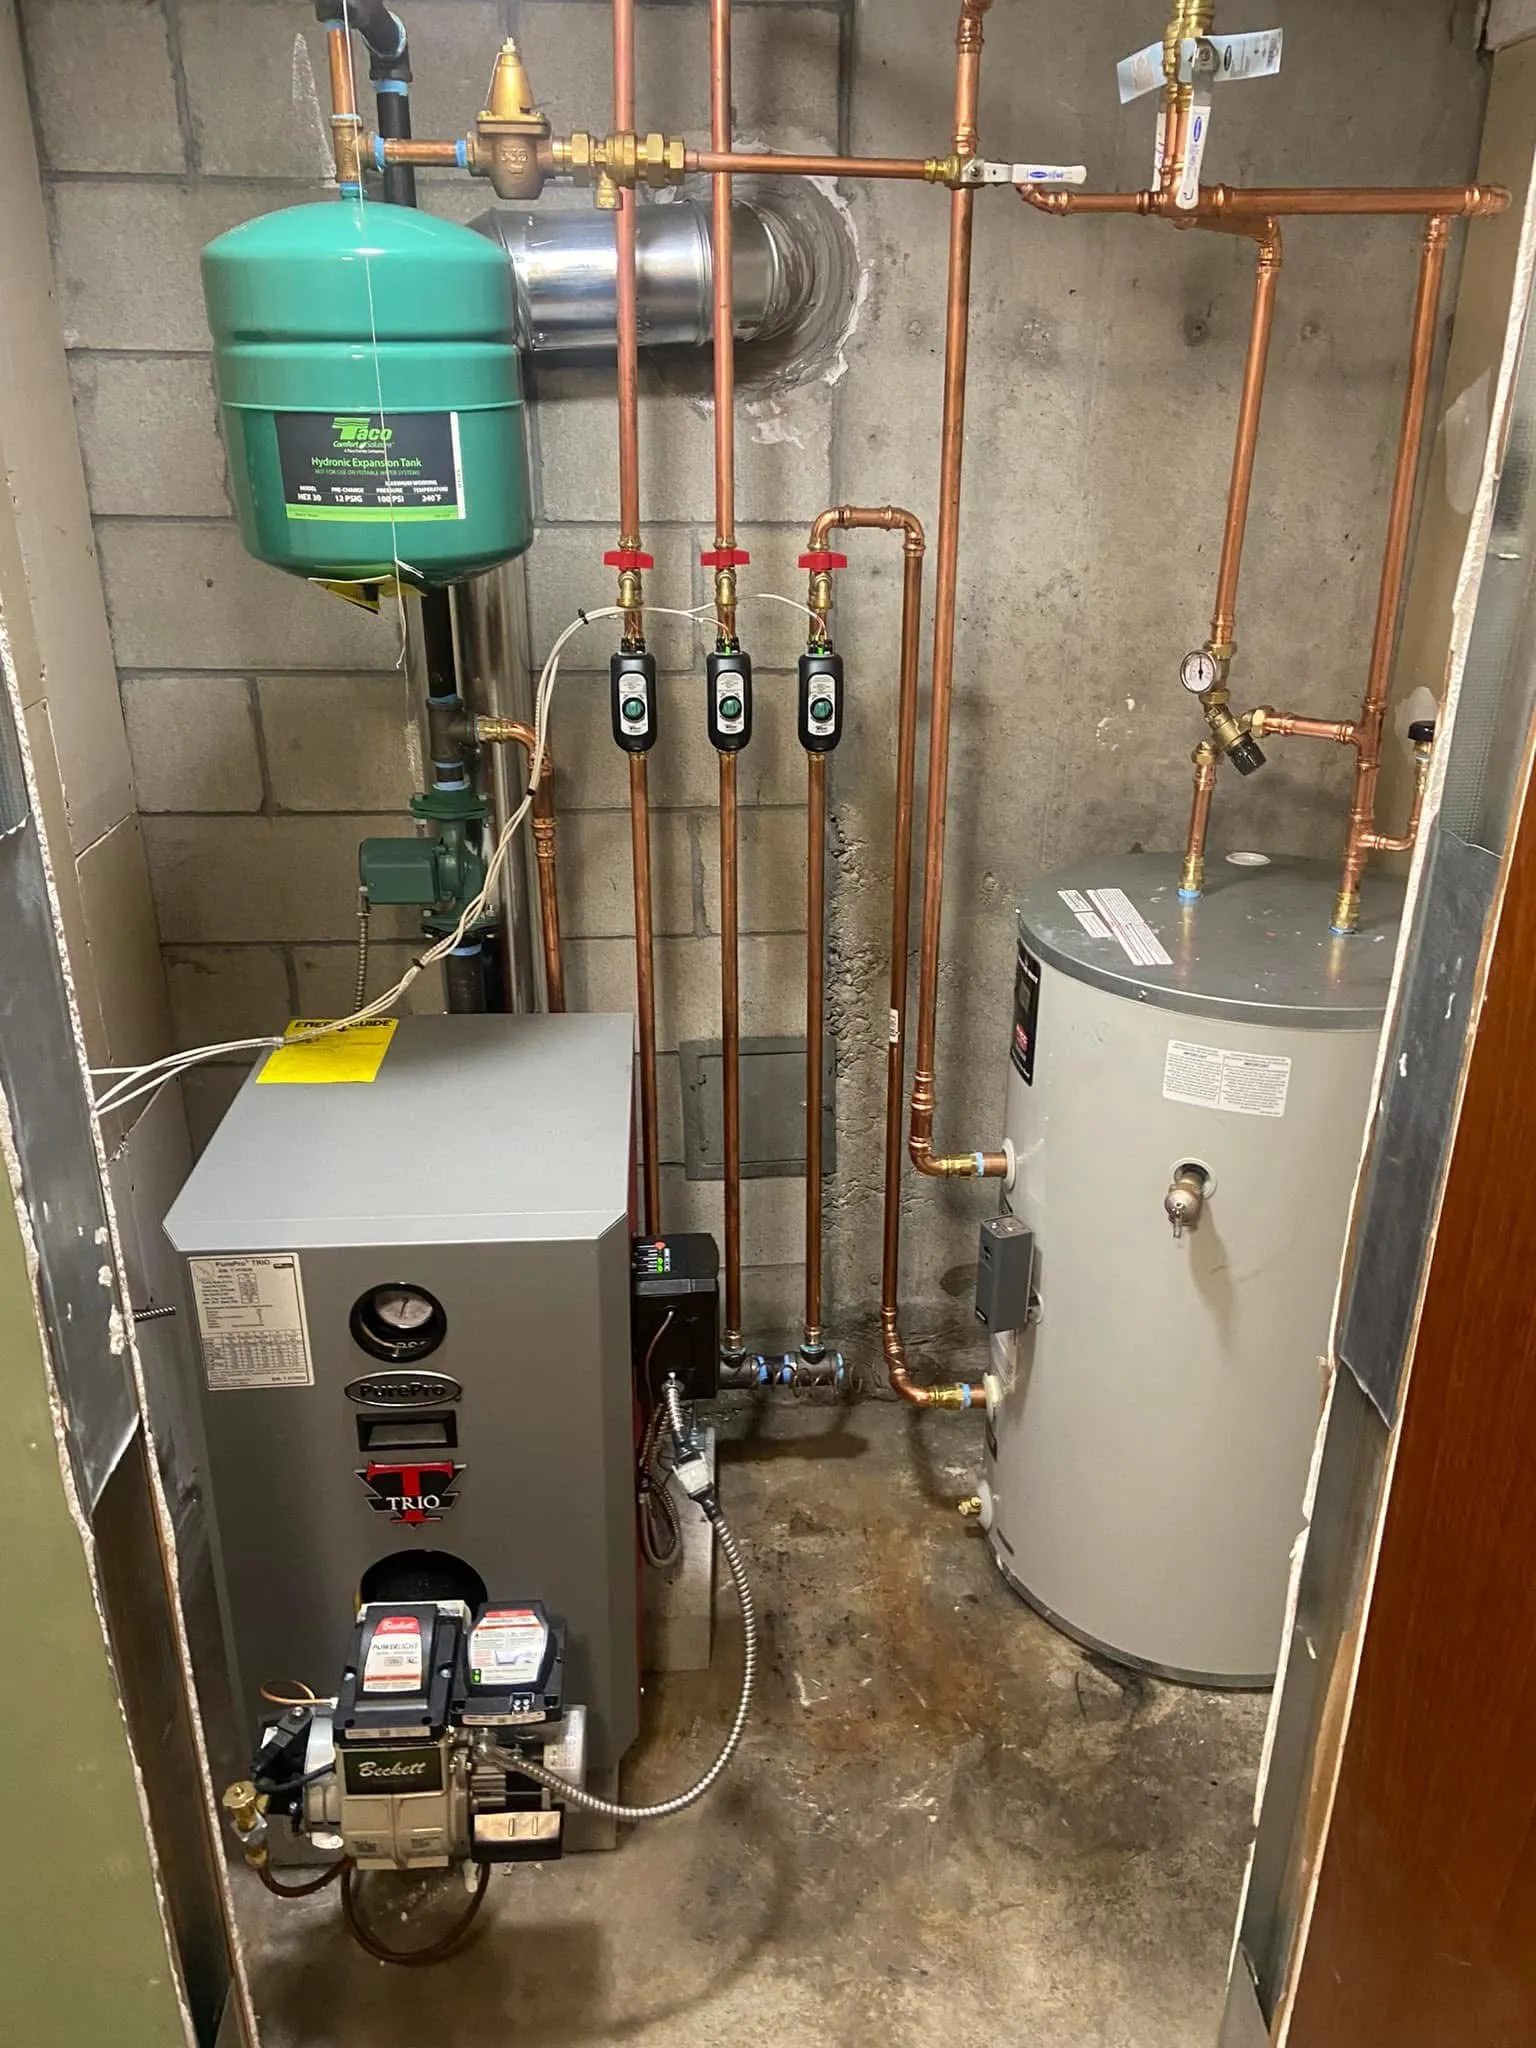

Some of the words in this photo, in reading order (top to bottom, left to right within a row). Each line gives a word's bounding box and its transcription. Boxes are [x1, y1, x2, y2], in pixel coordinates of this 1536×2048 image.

[332, 417, 393, 441] Taco
[311, 456, 351, 468] Hydronic
[352, 457, 399, 469] Expanson
[400, 457, 422, 467] Tank
[345, 495, 363, 503] PSIG
[377, 495, 391, 503] 100
[391, 495, 405, 503] PSI
[360, 1382, 446, 1397] PurePro
[385, 1494, 441, 1511] TRIO
[358, 1761, 426, 1777] Beckett
